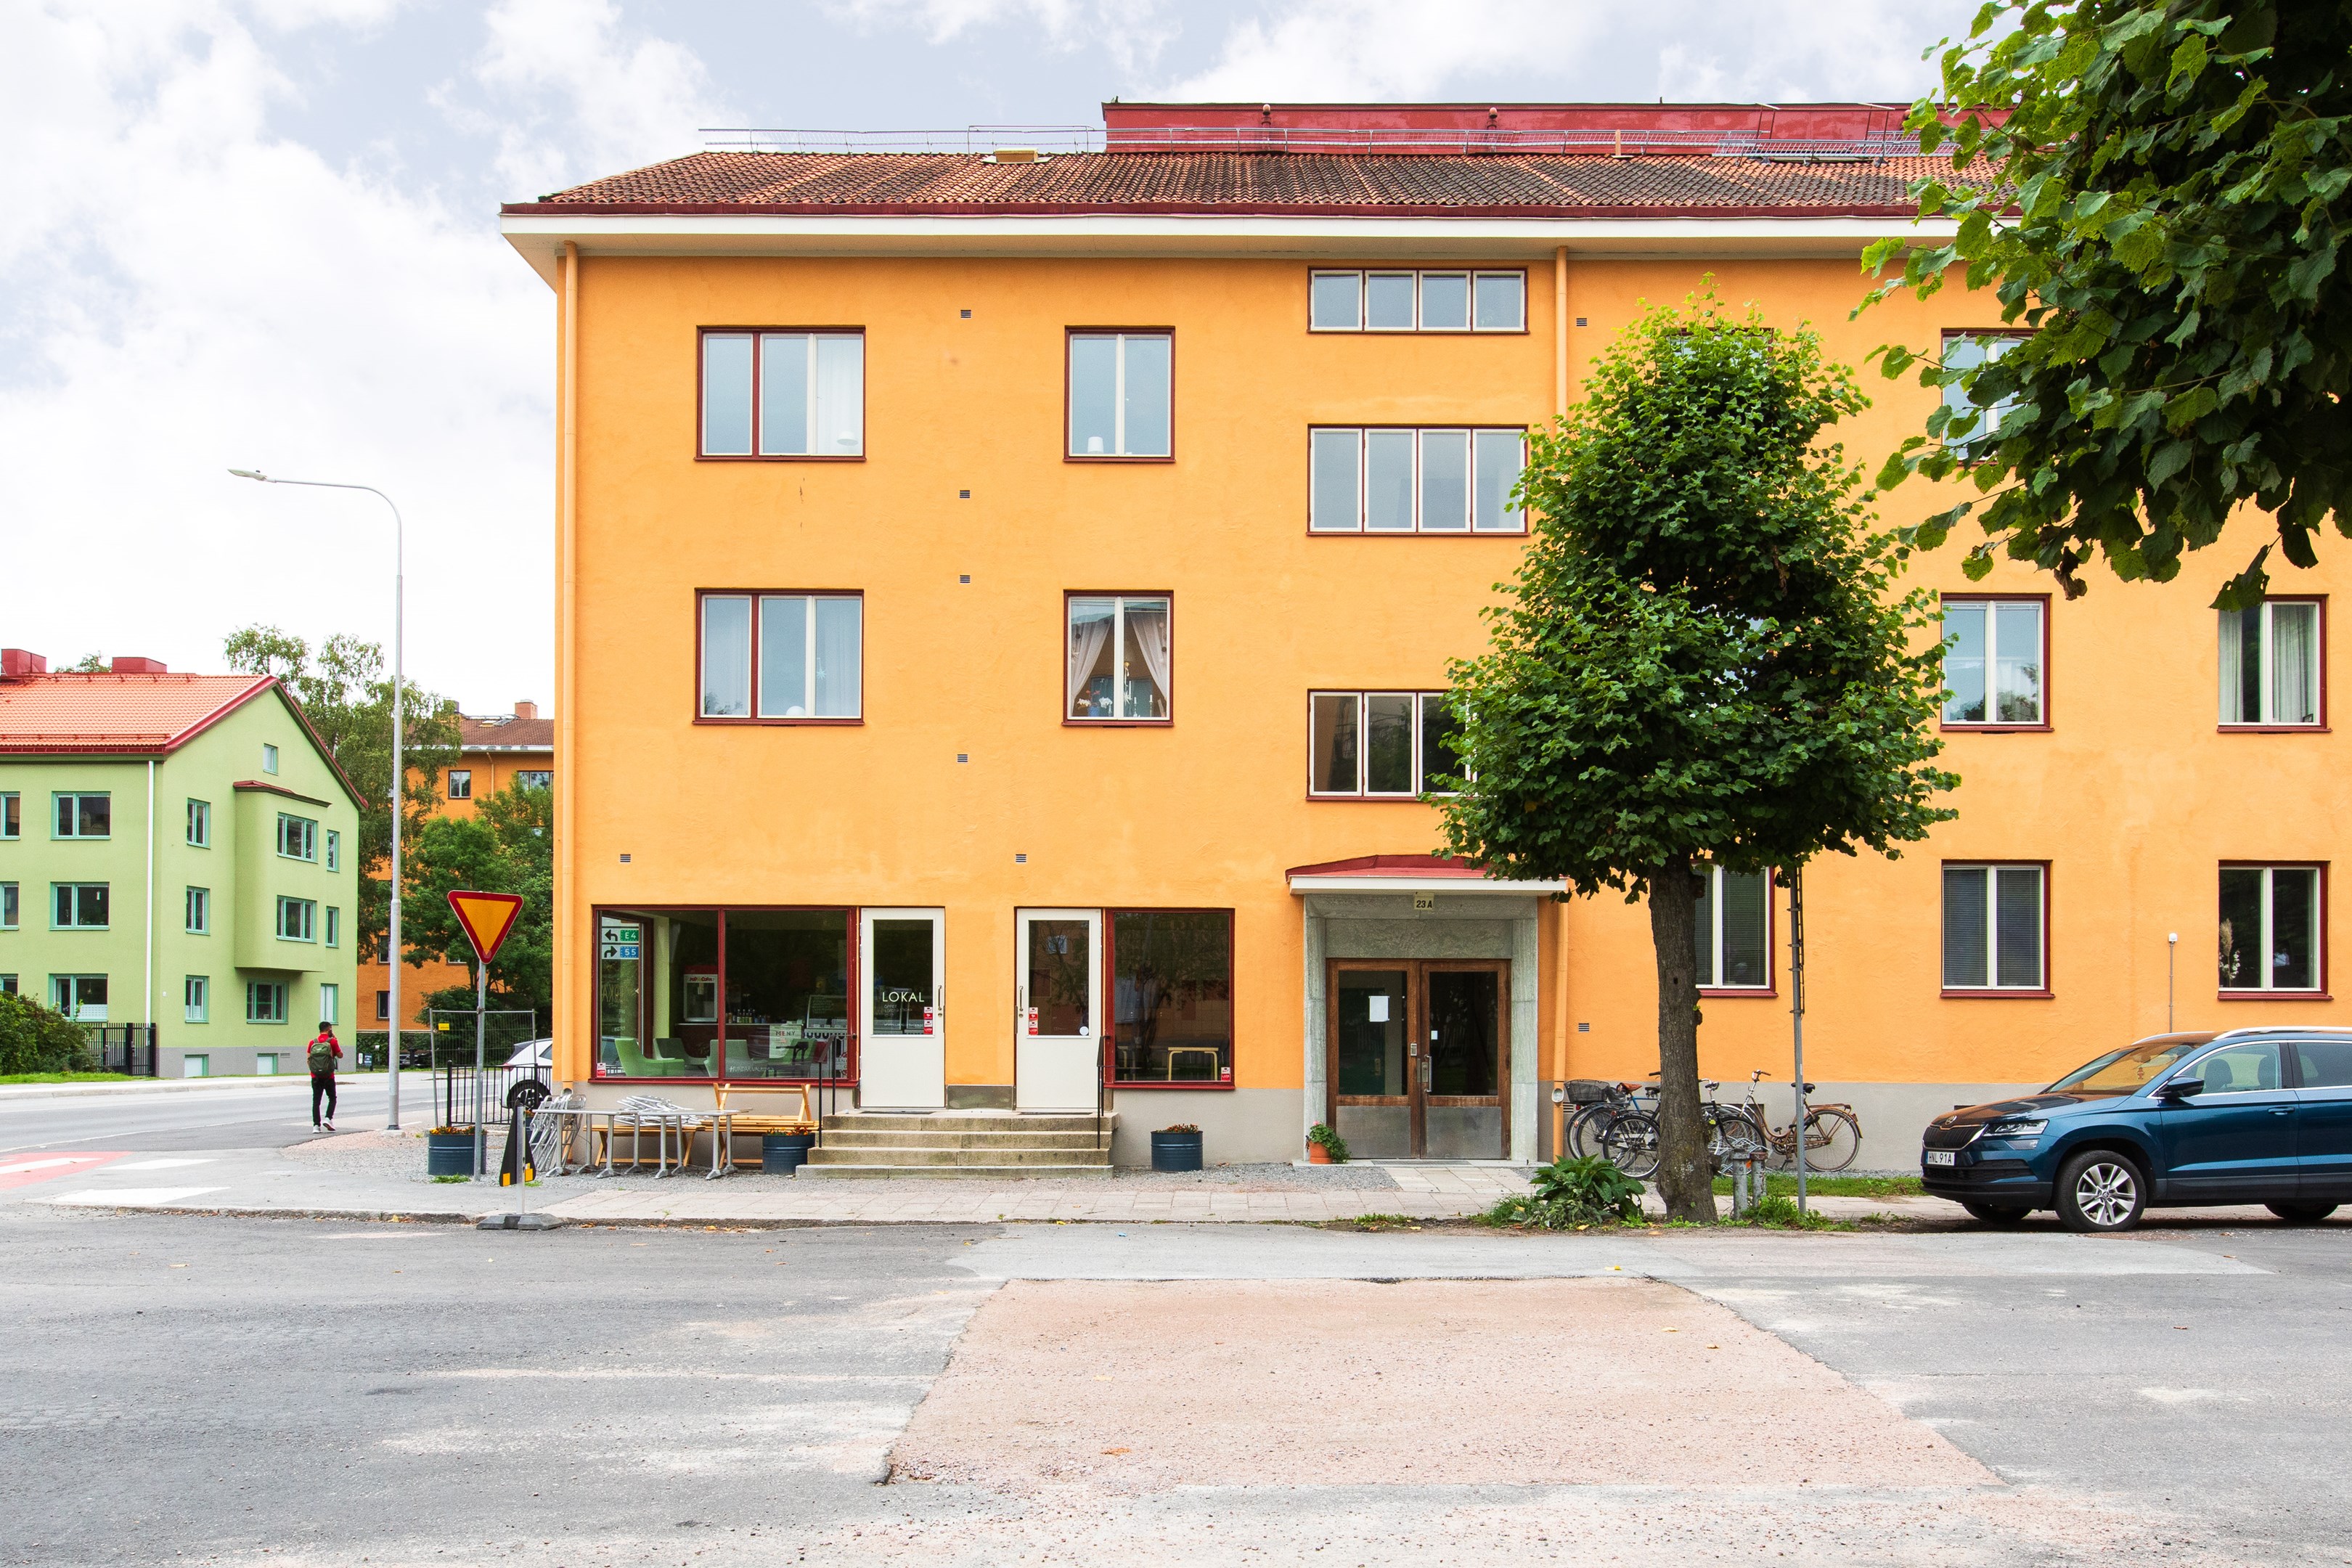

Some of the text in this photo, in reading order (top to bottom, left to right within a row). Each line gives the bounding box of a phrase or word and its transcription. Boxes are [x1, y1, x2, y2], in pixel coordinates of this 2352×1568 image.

[882, 992, 925, 1003] LOKAL
[1929, 1153, 1952, 1164] HNL 91A
